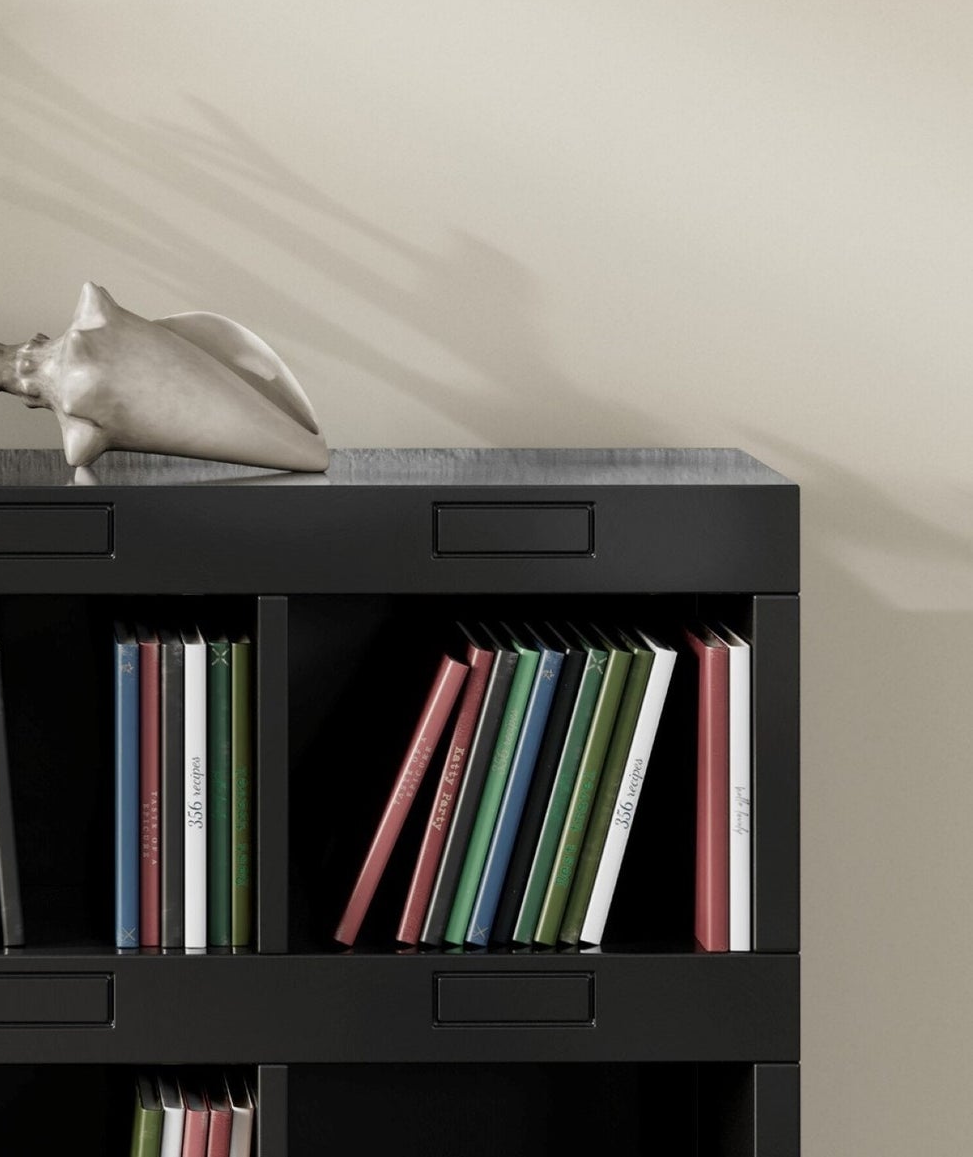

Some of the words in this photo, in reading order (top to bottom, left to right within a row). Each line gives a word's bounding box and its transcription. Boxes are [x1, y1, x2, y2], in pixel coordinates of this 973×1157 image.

[190, 756, 205, 796] recipes
[445, 746, 465, 786] Katty
[432, 792, 452, 832] Party
[615, 801, 634, 830] 356
[627, 758, 644, 797] recipes
[187, 801, 203, 829] 356
